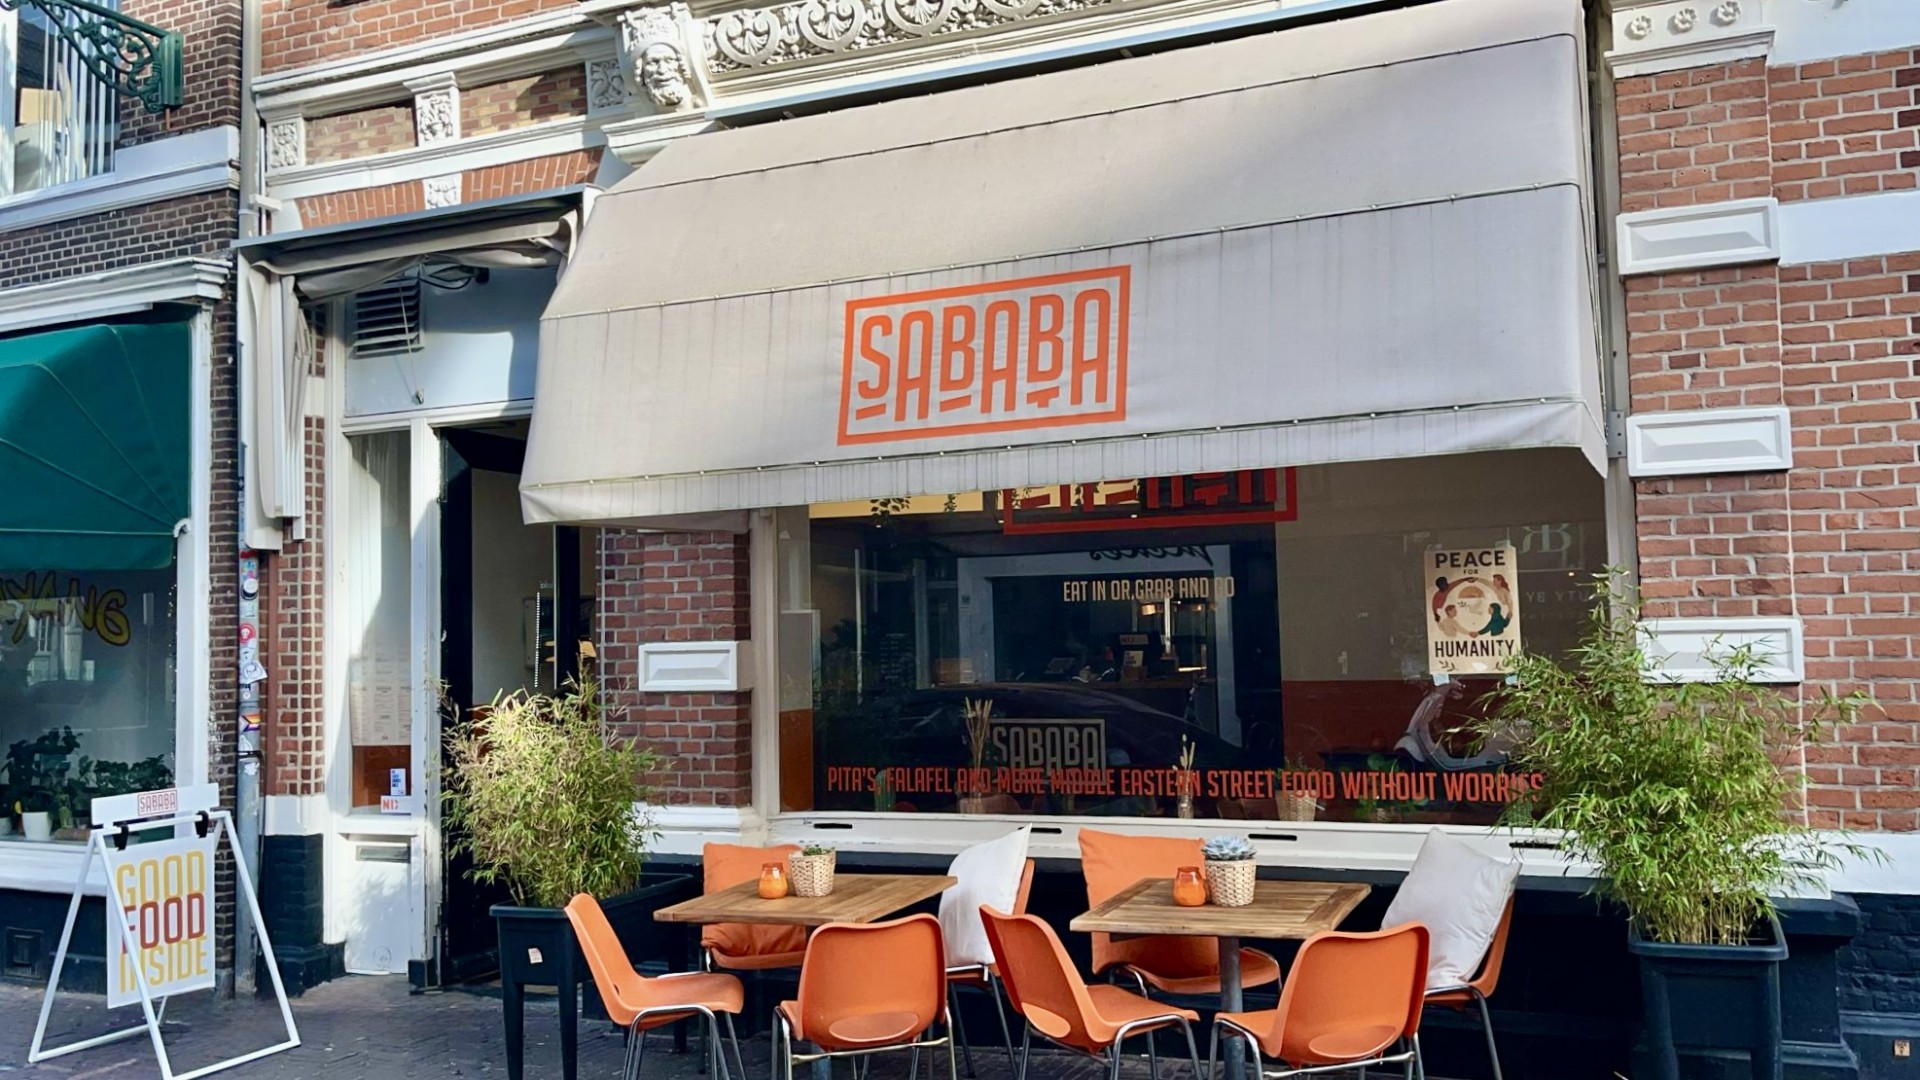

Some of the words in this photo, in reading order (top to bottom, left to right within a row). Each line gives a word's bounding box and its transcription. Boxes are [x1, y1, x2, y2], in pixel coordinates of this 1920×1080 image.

[855, 288, 1111, 421] SABABA
[1435, 550, 1506, 569] PEACE
[0, 571, 131, 647] YANG
[1063, 581, 1088, 602] EAT
[1092, 580, 1106, 601] IN
[1134, 578, 1174, 599] GRAB
[1179, 577, 1209, 599] AND
[1215, 576, 1235, 598] GO
[1435, 639, 1514, 658] HUMANITY
[993, 726, 1099, 779] SABABA
[139, 792, 176, 813] SABABA
[886, 767, 952, 793] FALAFEL
[957, 767, 991, 793] AND
[998, 767, 1045, 794] MORE
[1051, 768, 1115, 795] MIDDLE
[1121, 769, 1201, 796] EASTERN
[1207, 770, 1275, 798] STREET
[1282, 771, 1335, 799] FOOD
[1341, 772, 1437, 801] WITHOUT
[116, 851, 205, 907] GOOD
[121, 892, 205, 954] FOOD
[119, 936, 208, 993] INSIDE
